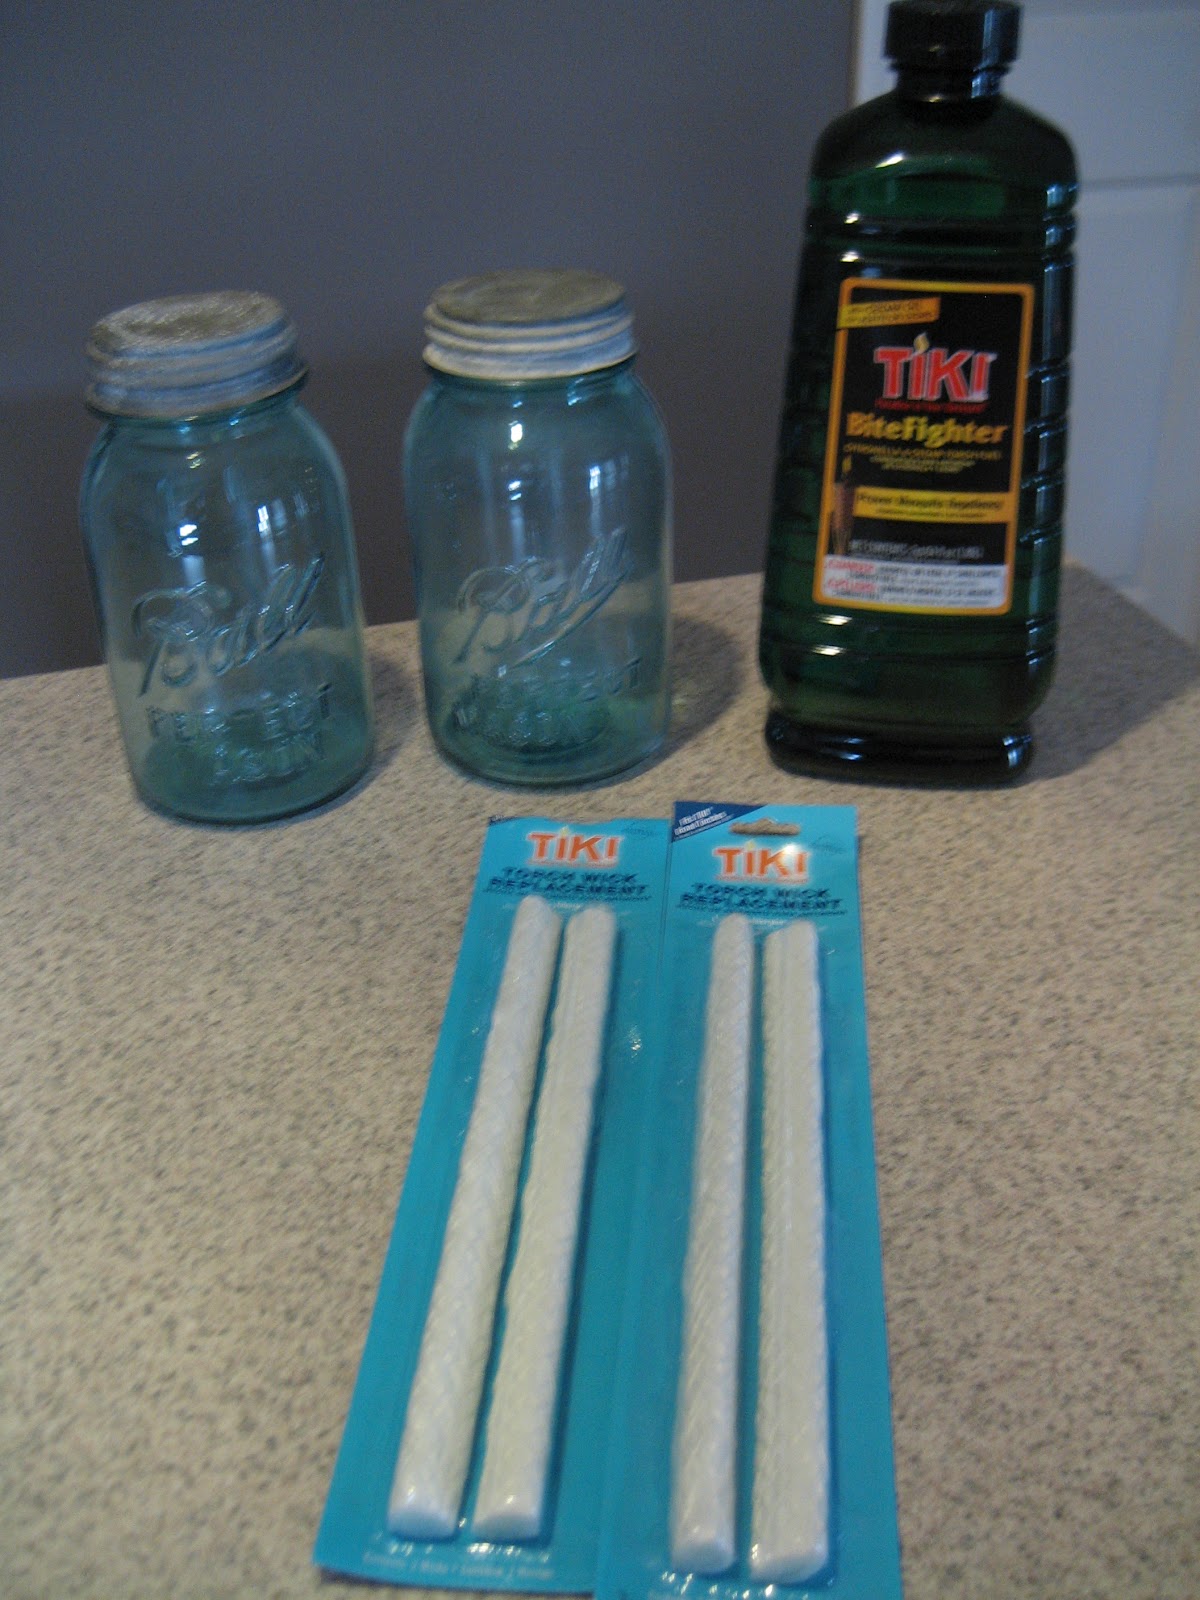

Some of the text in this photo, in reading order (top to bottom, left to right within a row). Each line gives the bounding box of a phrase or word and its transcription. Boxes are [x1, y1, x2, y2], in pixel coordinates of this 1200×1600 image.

[873, 346, 998, 403] TIKI
[526, 828, 624, 866] TIKI
[713, 843, 810, 883] TIKI
[487, 877, 650, 896] REPLACEMENT
